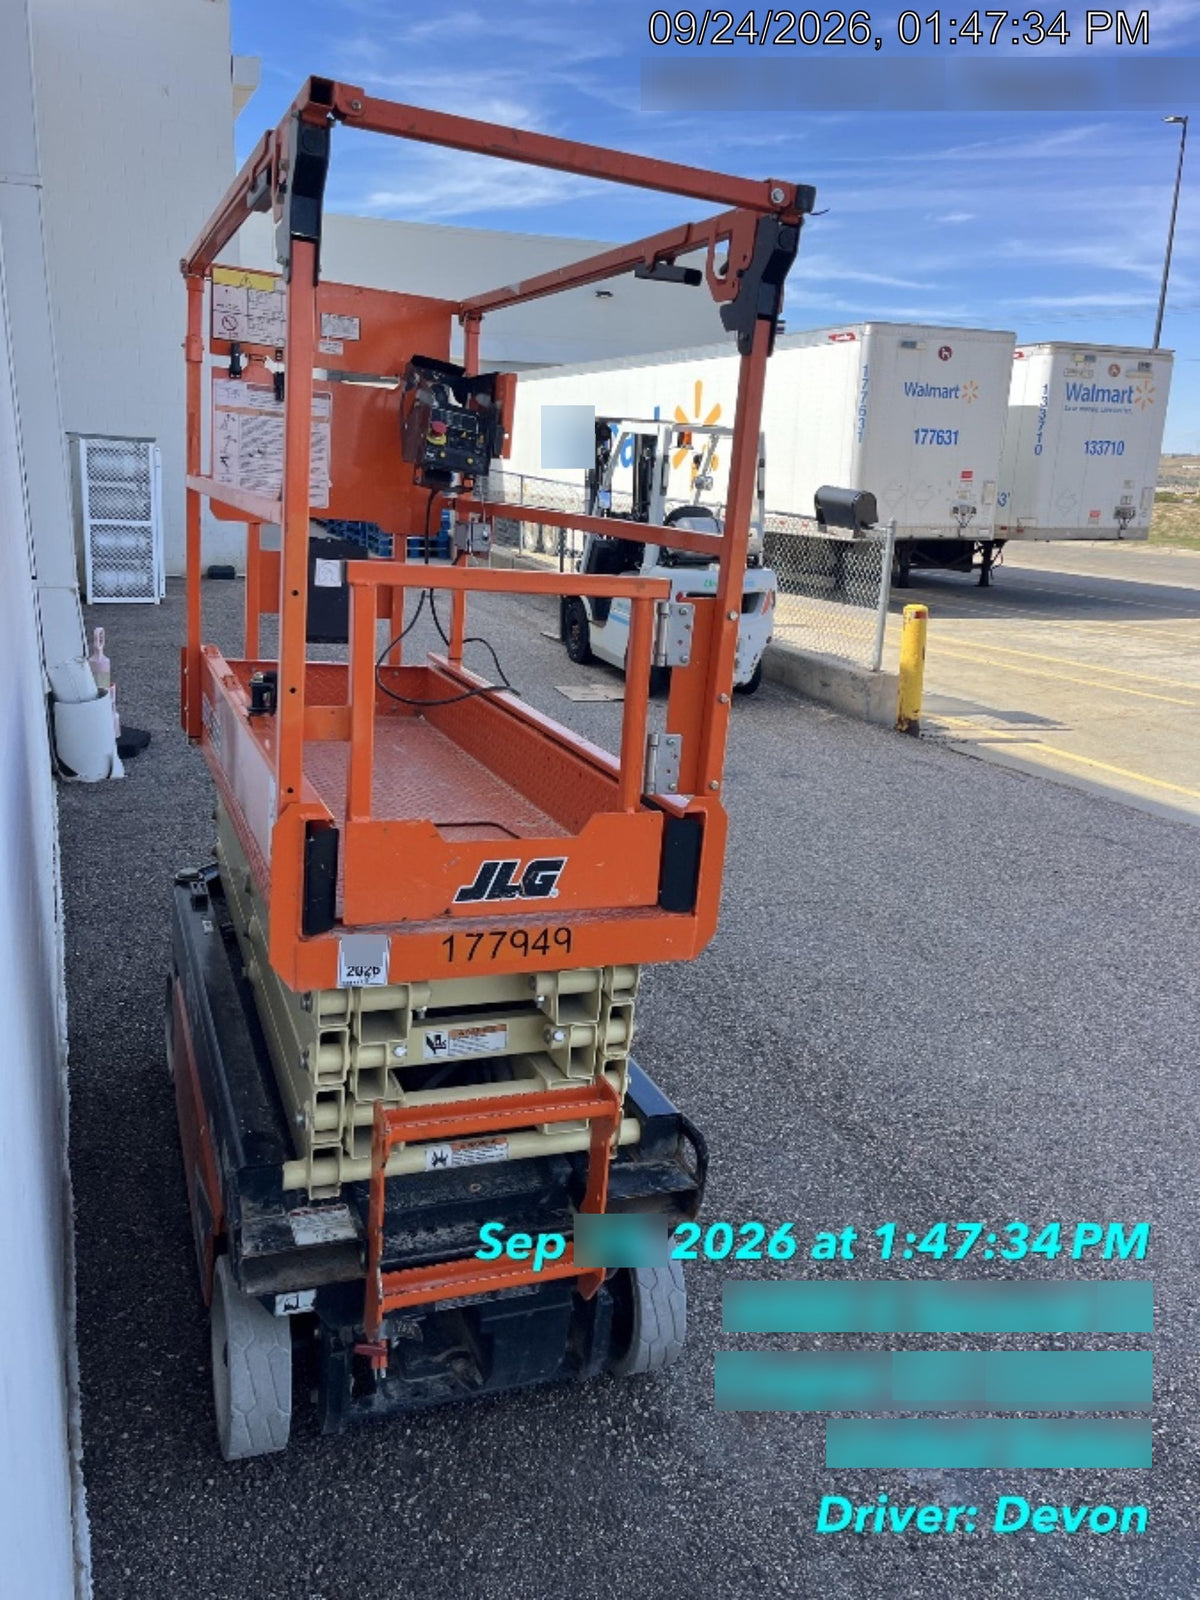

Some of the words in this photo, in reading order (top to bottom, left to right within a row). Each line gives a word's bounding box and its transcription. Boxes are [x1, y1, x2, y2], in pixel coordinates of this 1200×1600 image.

[904, 381, 960, 399] Walmart
[1065, 382, 1134, 404] Walmart
[914, 428, 959, 446] 177631
[1083, 440, 1125, 456] 133710
[452, 857, 568, 904] JLG
[441, 927, 572, 963] 177949
